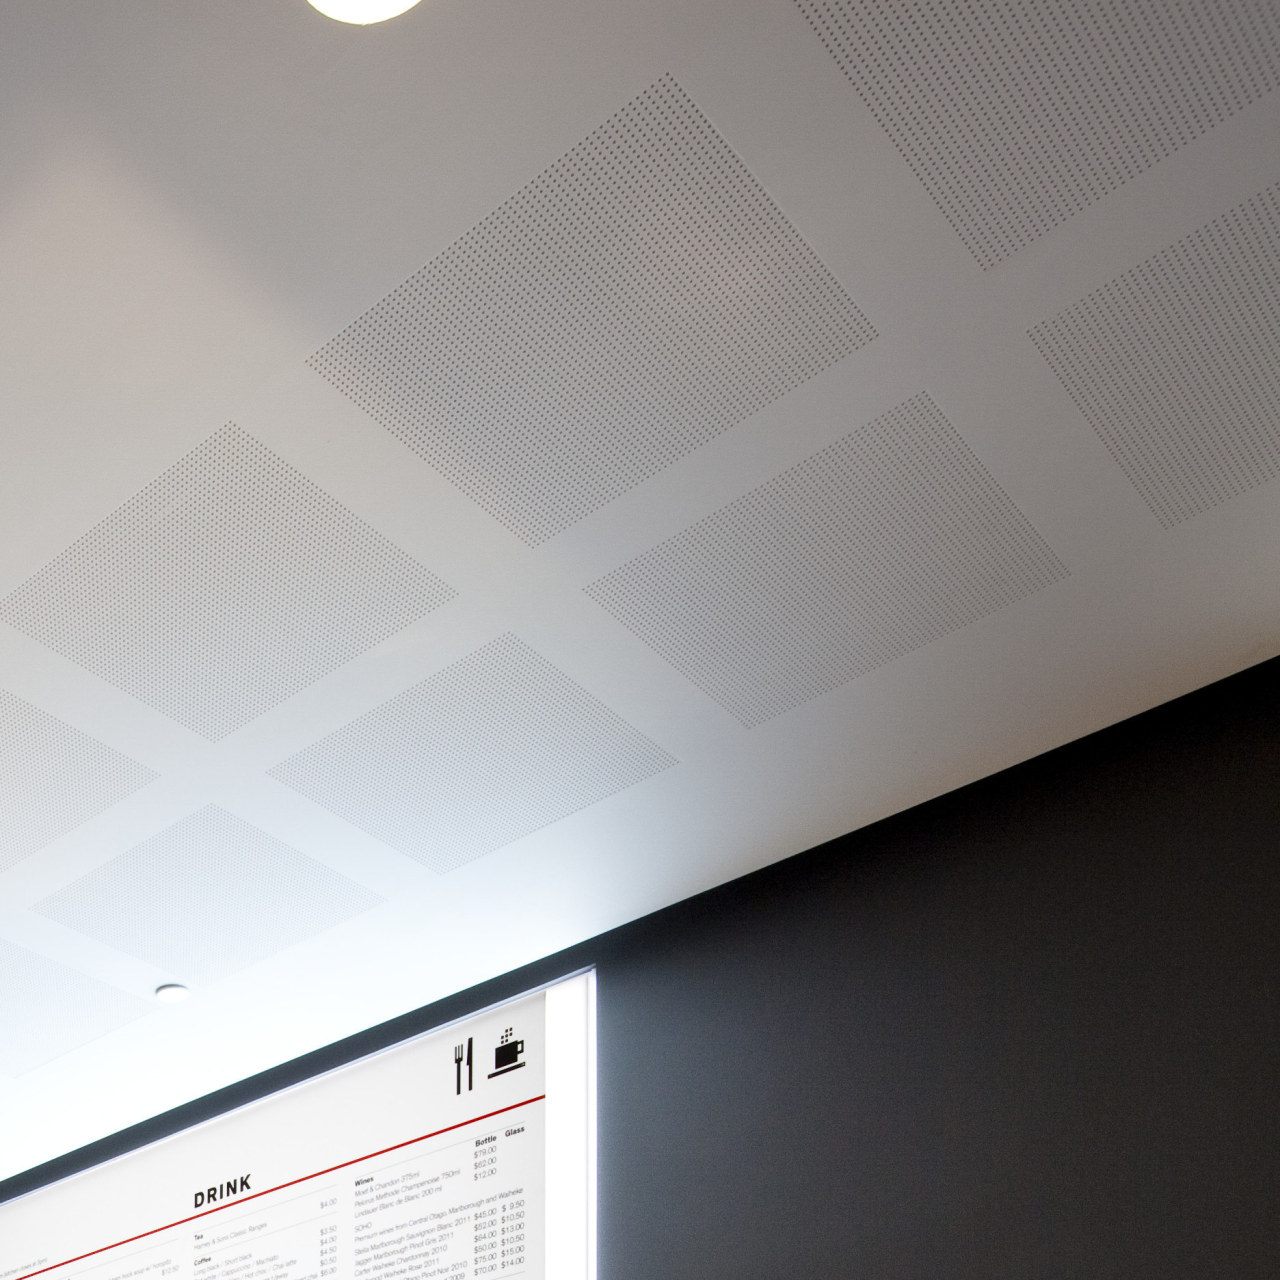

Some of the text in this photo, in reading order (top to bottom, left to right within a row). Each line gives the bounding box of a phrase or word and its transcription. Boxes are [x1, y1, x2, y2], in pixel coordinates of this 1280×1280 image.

[355, 1126, 525, 1188] Wines Bottle Glass
[474, 1168, 496, 1182] $12.00
[194, 1174, 252, 1208] DRINK
[474, 1207, 497, 1221] $45.00
[194, 1257, 211, 1267] Coffee
[474, 1252, 496, 1266] $75.00
[501, 1245, 524, 1258] $15.00
[474, 1264, 496, 1277] $70.00
[501, 1256, 524, 1269] $14.00
